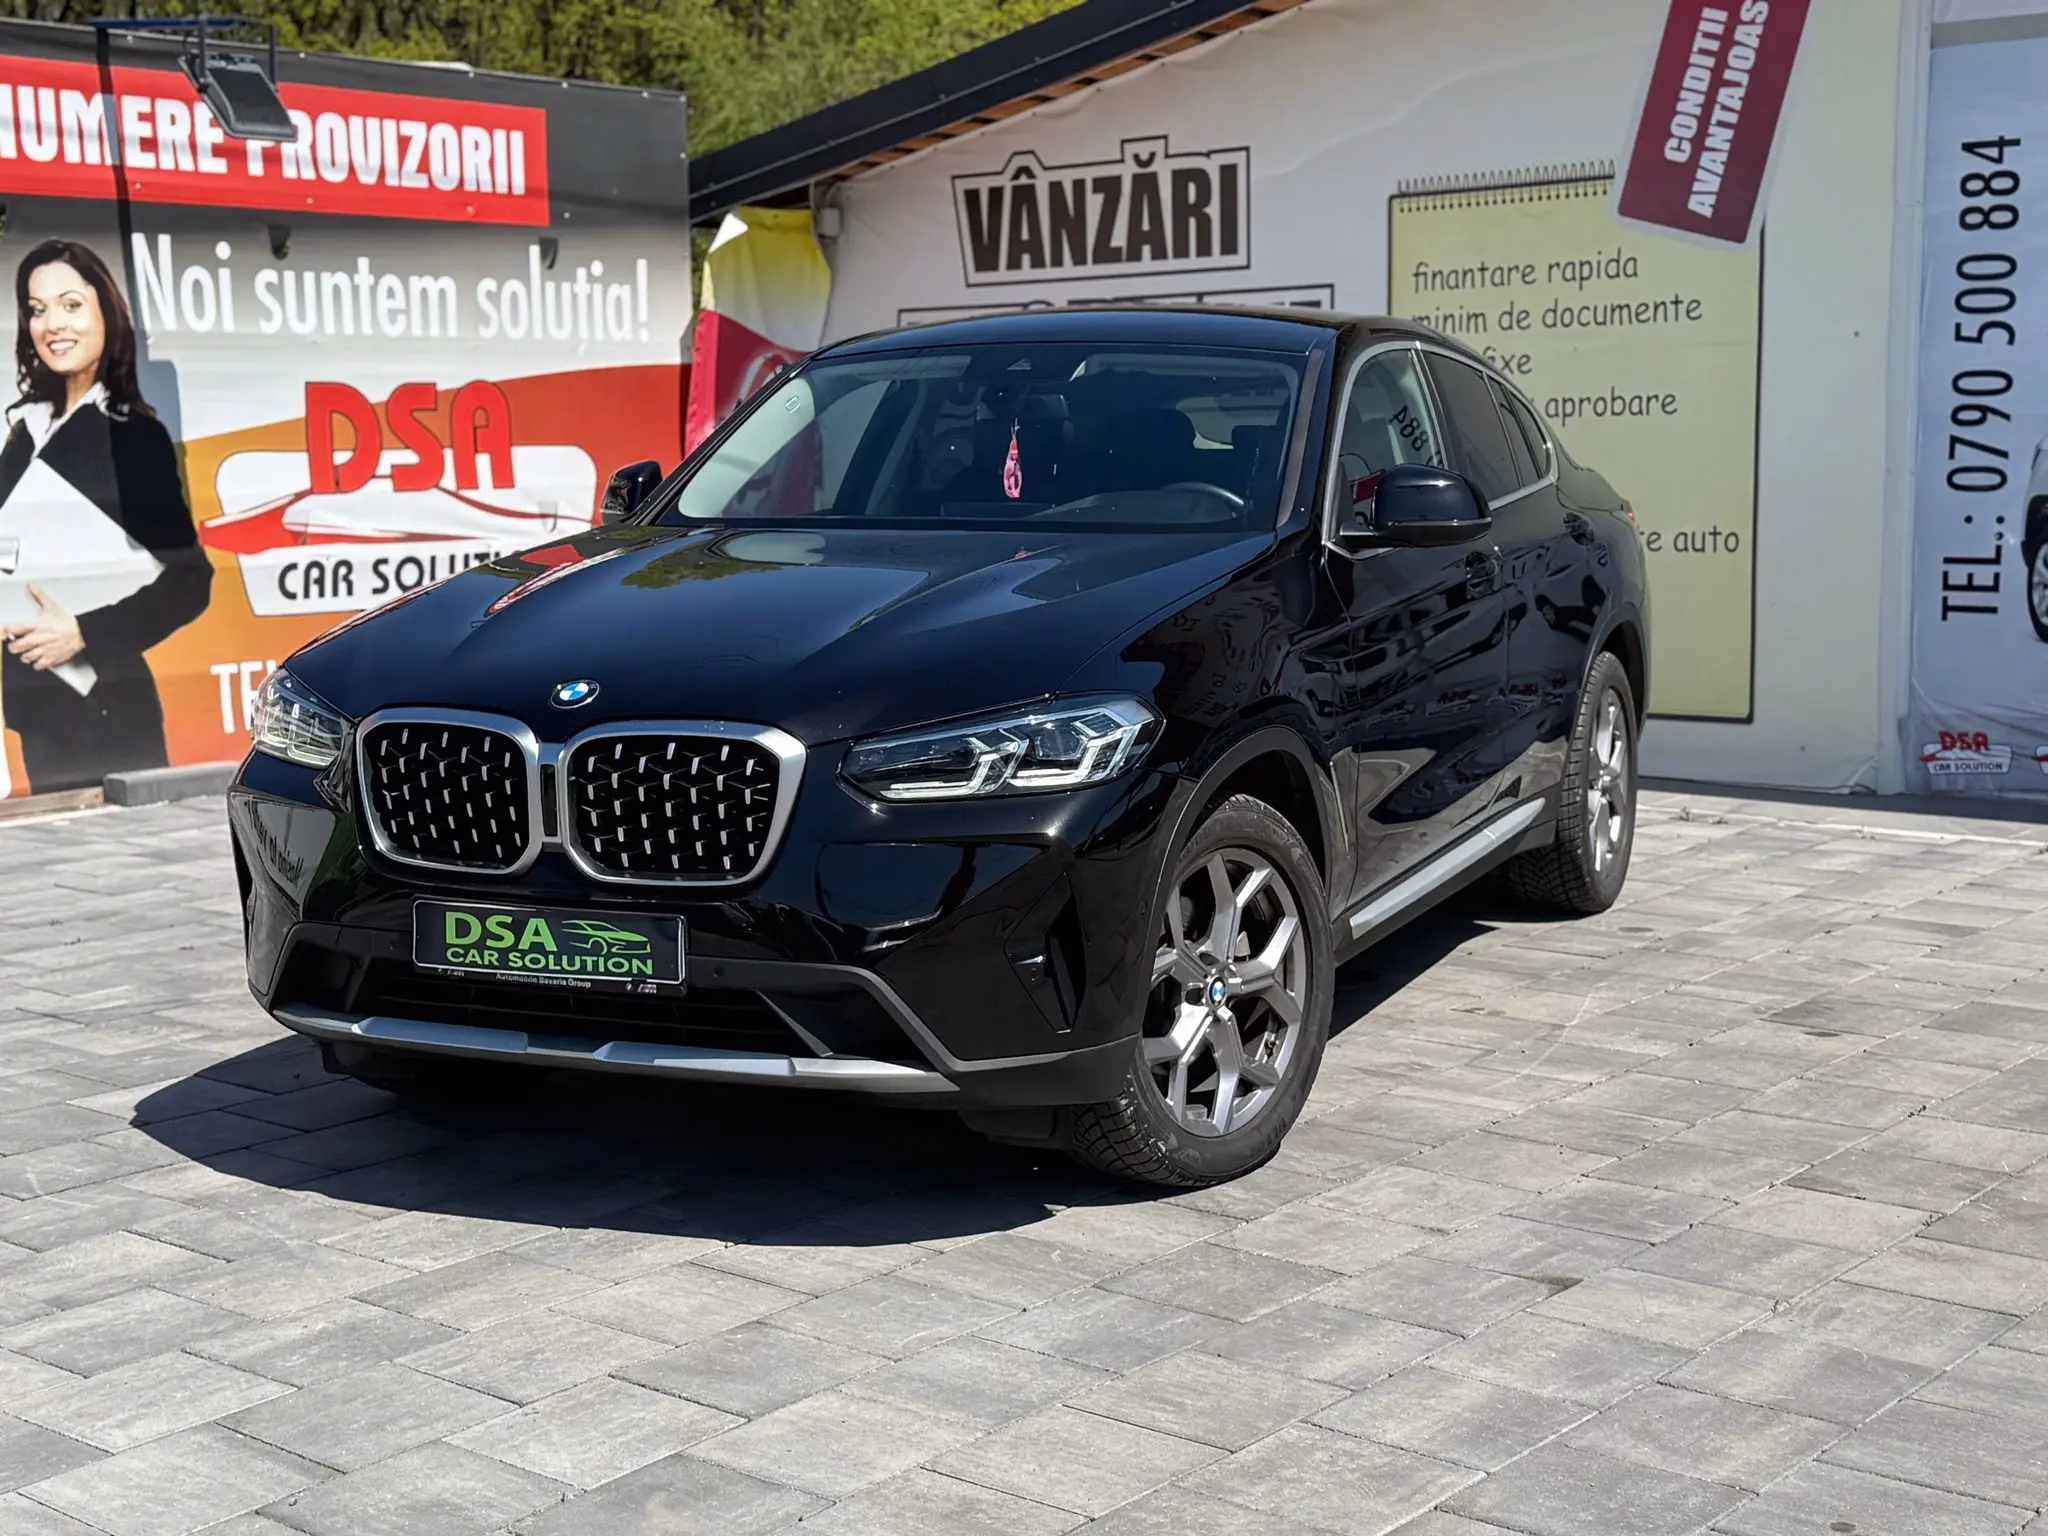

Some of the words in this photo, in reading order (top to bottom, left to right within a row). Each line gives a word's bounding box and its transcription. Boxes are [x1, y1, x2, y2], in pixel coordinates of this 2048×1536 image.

[1664, 7, 1728, 163] CONDITII
[963, 151, 1240, 272] VÂNZĂRI
[1958, 135, 2021, 232] 884
[131, 232, 233, 334] Noi
[254, 257, 458, 338] suntem
[1412, 261, 1537, 293] finantare
[1547, 248, 1638, 291] rapida
[1955, 253, 2018, 346] 500
[1498, 300, 1532, 331] de
[1542, 294, 1703, 328] documente
[305, 380, 515, 494] DSA
[1545, 386, 1678, 427] aprobare
[1947, 369, 2013, 494] 0790
[1673, 524, 1740, 553] auto
[278, 560, 353, 600] CAR
[372, 552, 500, 595] SOLUT
[210, 660, 277, 734] TE
[445, 911, 558, 951] DSA
[446, 948, 500, 966] CAR
[507, 952, 654, 974] SOLUTION
